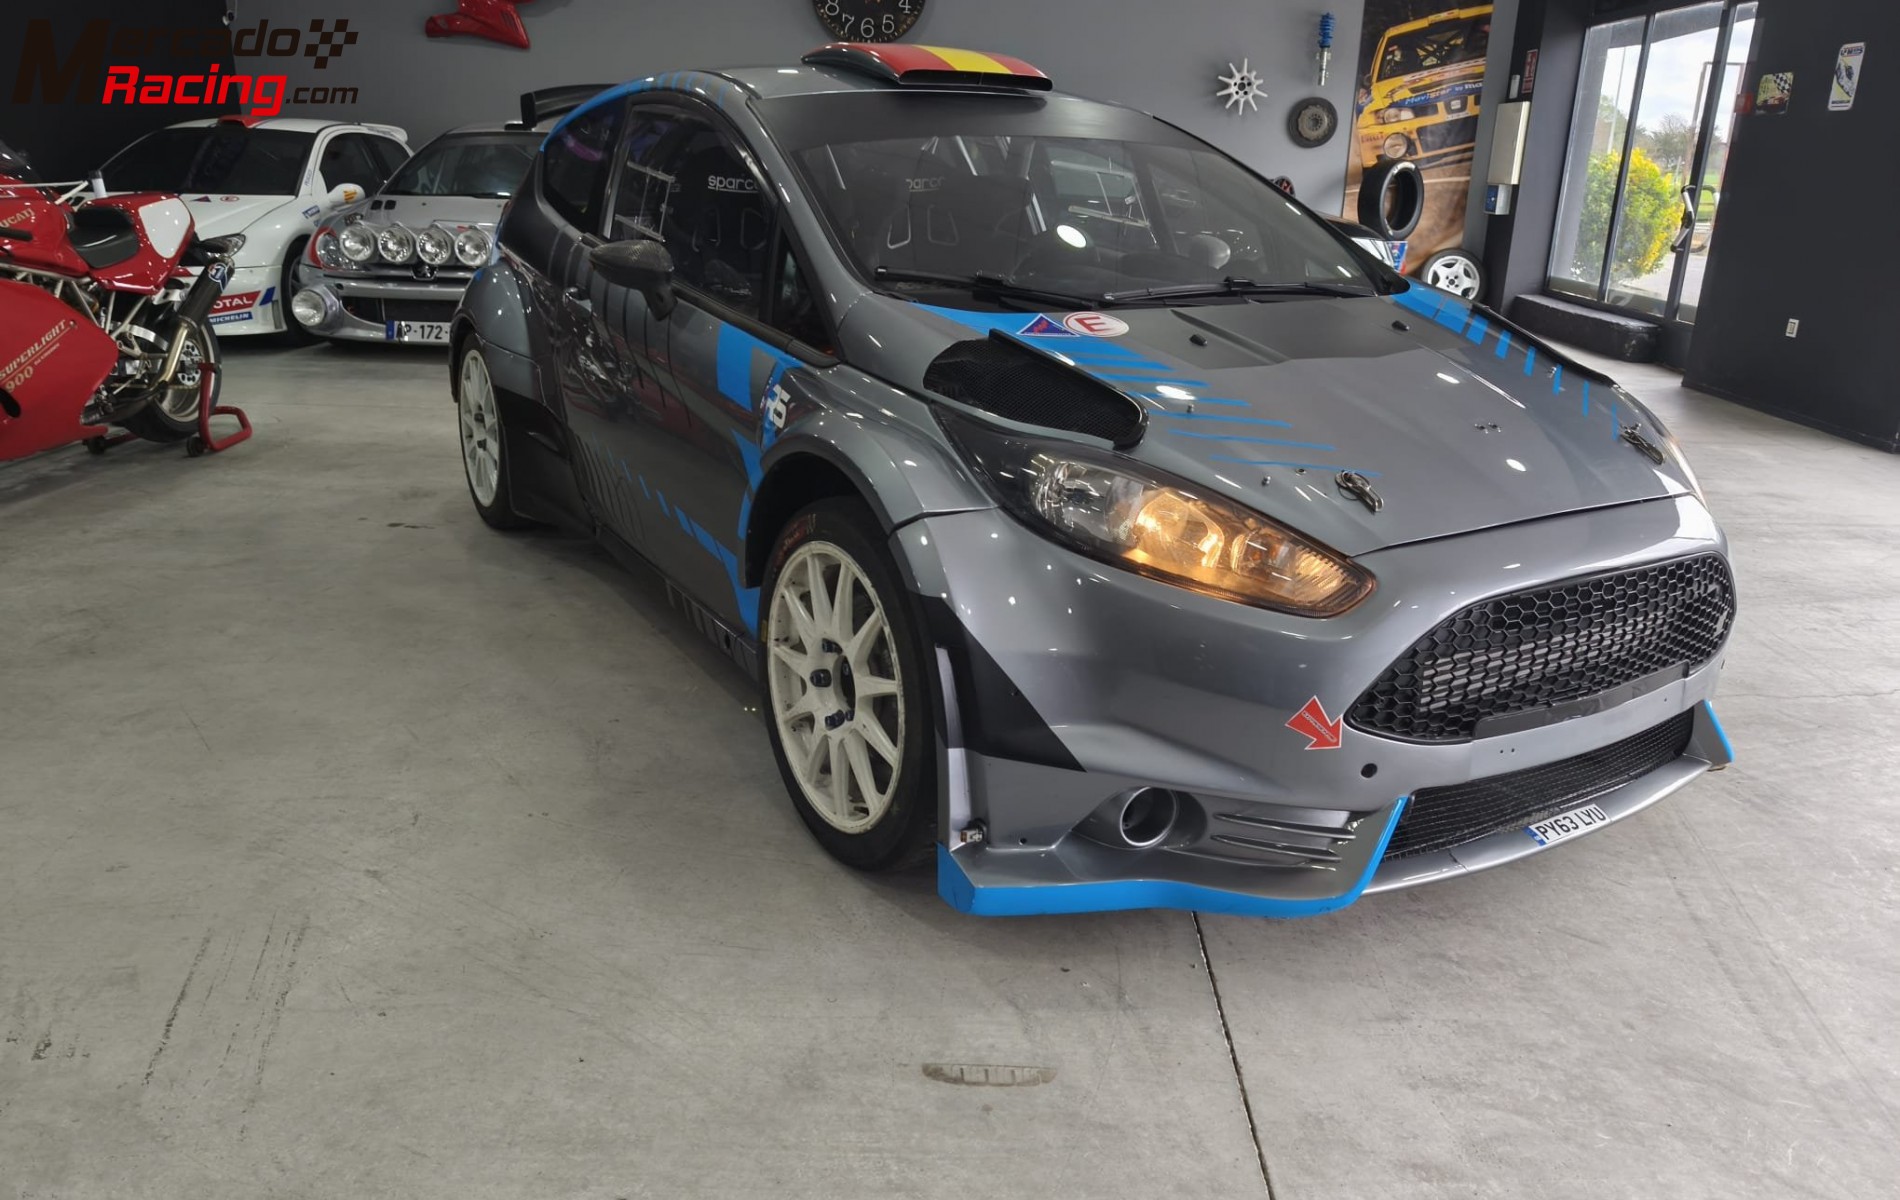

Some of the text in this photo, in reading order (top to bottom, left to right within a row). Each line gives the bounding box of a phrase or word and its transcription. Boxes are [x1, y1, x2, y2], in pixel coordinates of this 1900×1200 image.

[842, 13, 855, 34] 7
[860, 17, 875, 38] 6
[881, 14, 895, 34] 5
[707, 175, 759, 192] sparc
[213, 296, 253, 309] OTAL
[1074, 316, 1113, 332] E
[6, 366, 33, 393] 900
[1534, 806, 1607, 840] PY63 LYU
